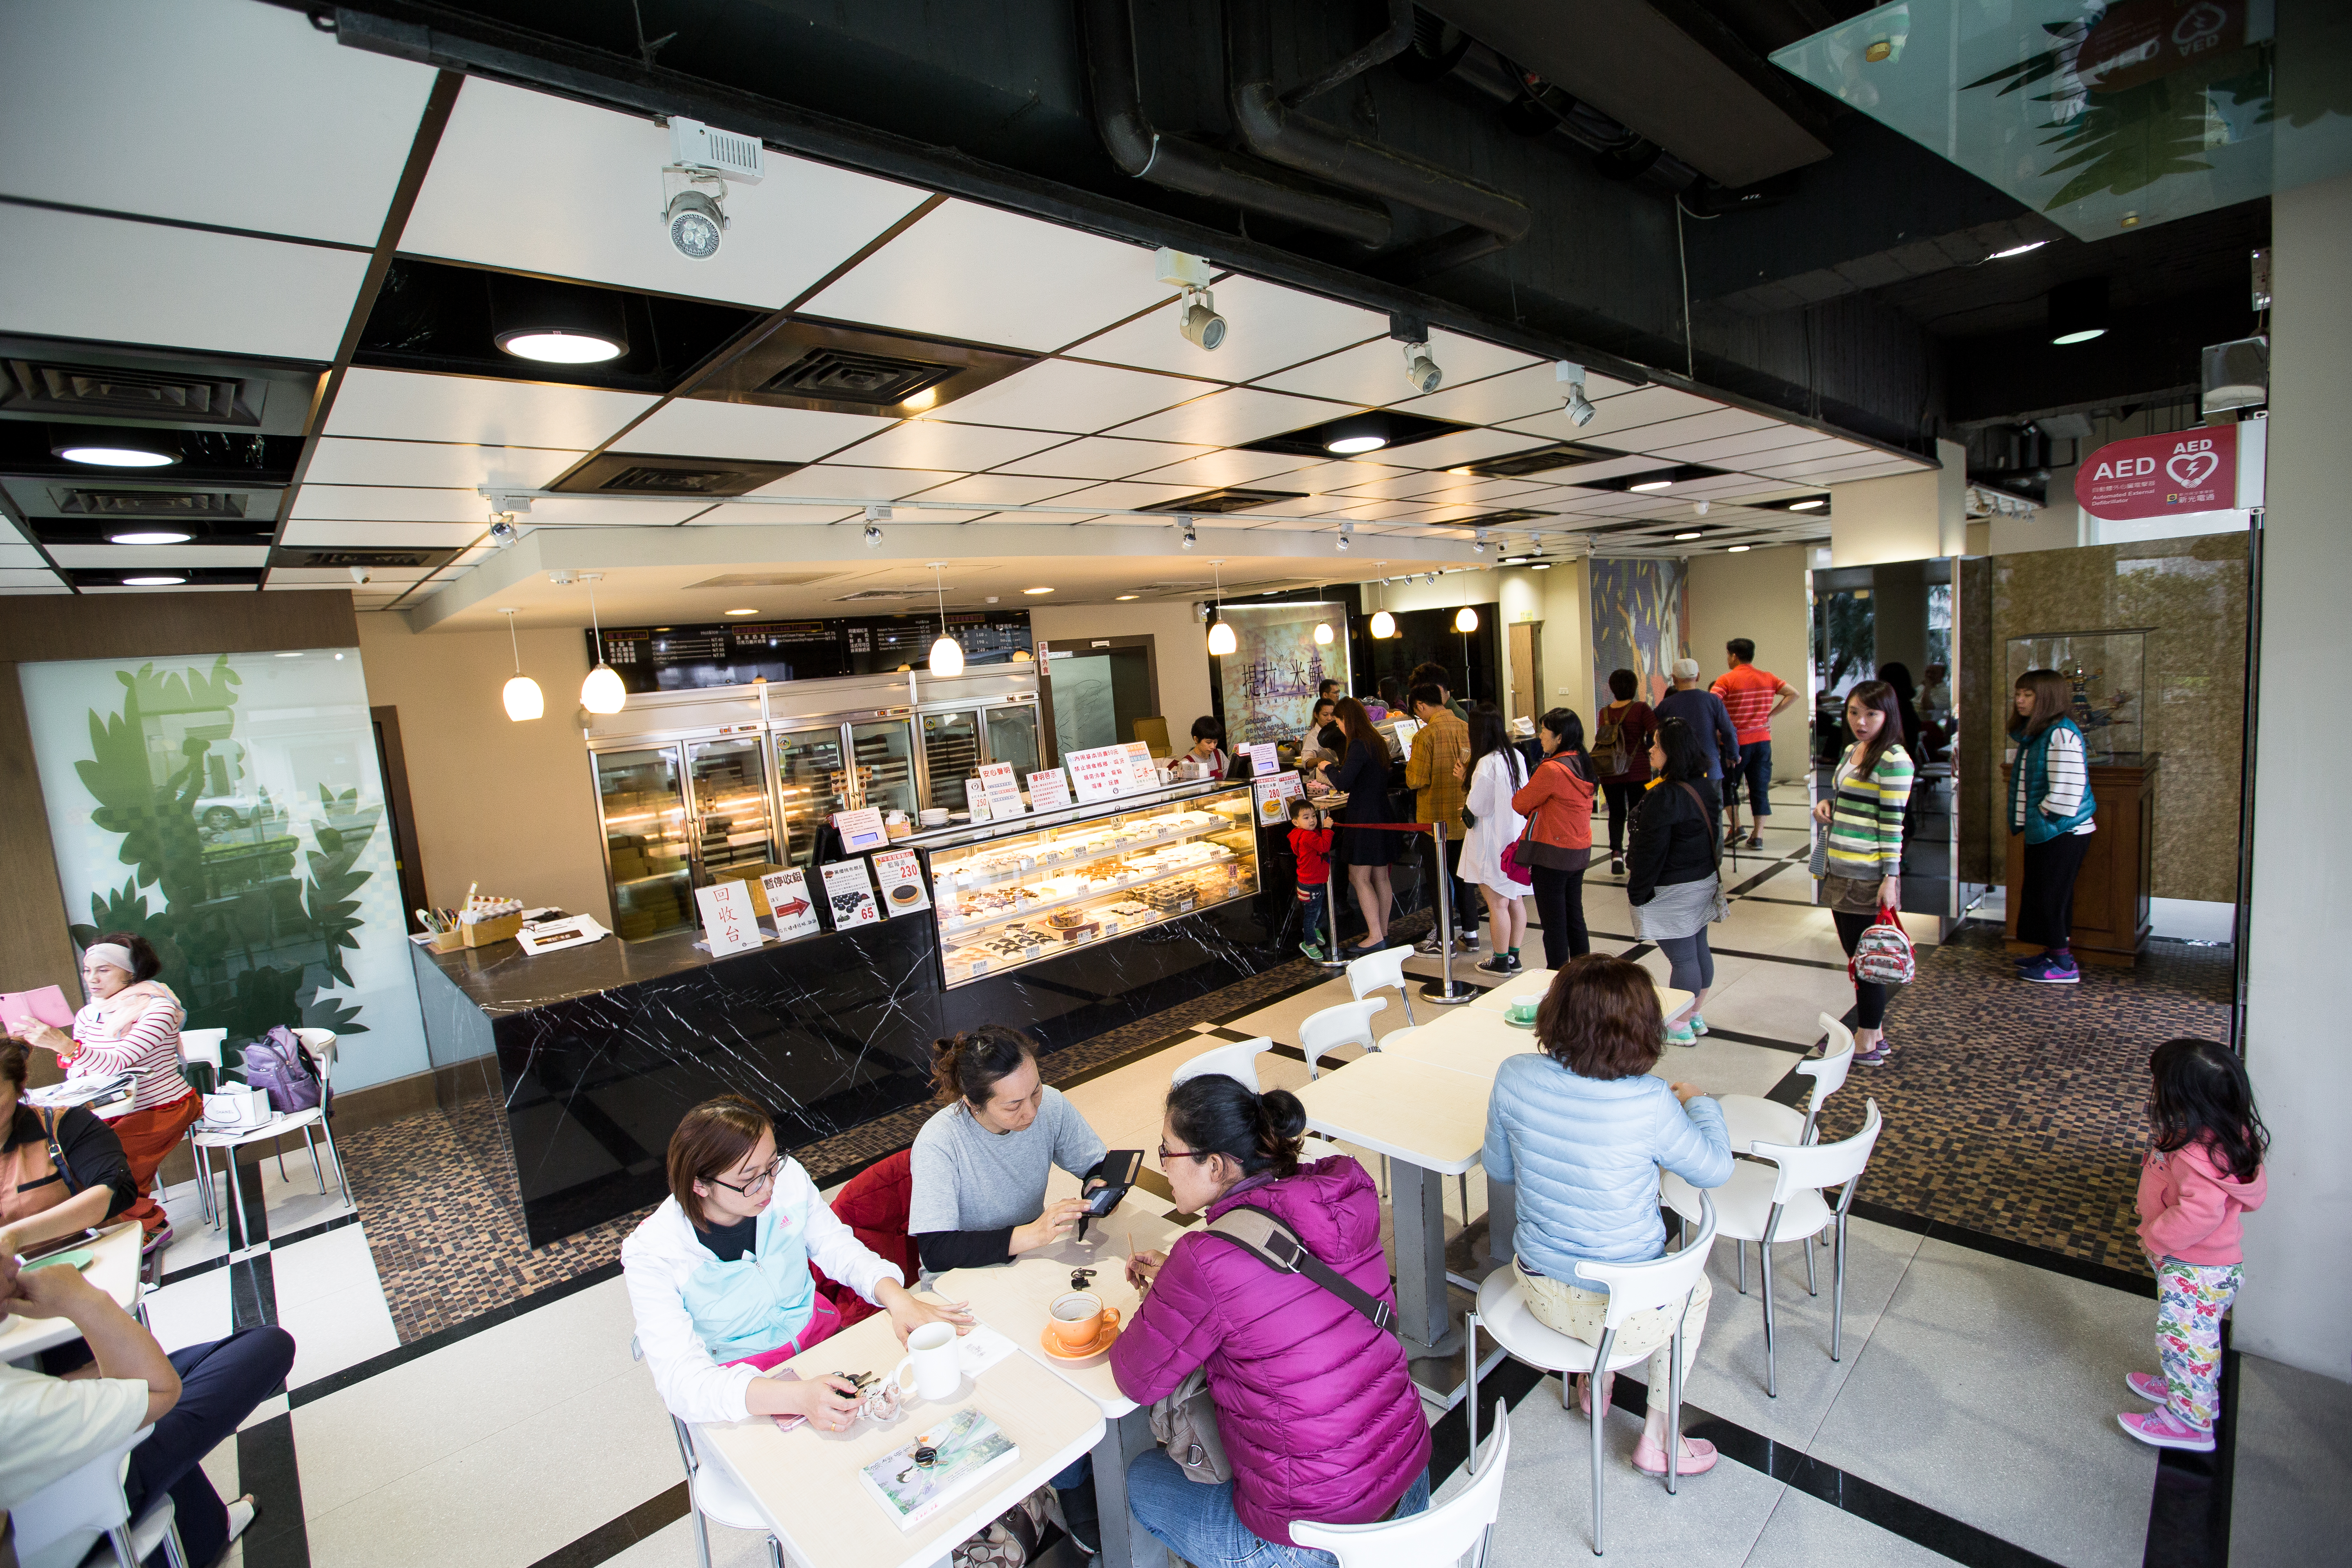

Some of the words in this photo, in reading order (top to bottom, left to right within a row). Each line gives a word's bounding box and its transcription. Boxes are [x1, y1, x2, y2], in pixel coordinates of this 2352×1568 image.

[2173, 439, 2213, 454] AED
[2093, 457, 2156, 481] AED
[2092, 491, 2127, 501] Automated
[2128, 488, 2155, 497] External
[2091, 497, 2129, 506] Defibrillator
[1040, 643, 1049, 674] 禁帶外食
[1242, 657, 1323, 699] 提拉米蘇
[983, 766, 1011, 777] 安心聲明
[1133, 766, 1154, 779] 二送一
[1269, 788, 1280, 798] 280
[1294, 785, 1301, 794] 65
[977, 799, 987, 807] 250
[834, 864, 864, 875] 黑櫻桃布朗尼
[887, 860, 906, 869] 藍莓派
[900, 864, 918, 878] 230
[764, 871, 803, 890] 暫停收銀
[713, 888, 739, 942] 回收台
[861, 906, 873, 919] 65
[779, 1221, 793, 1229] adidas
